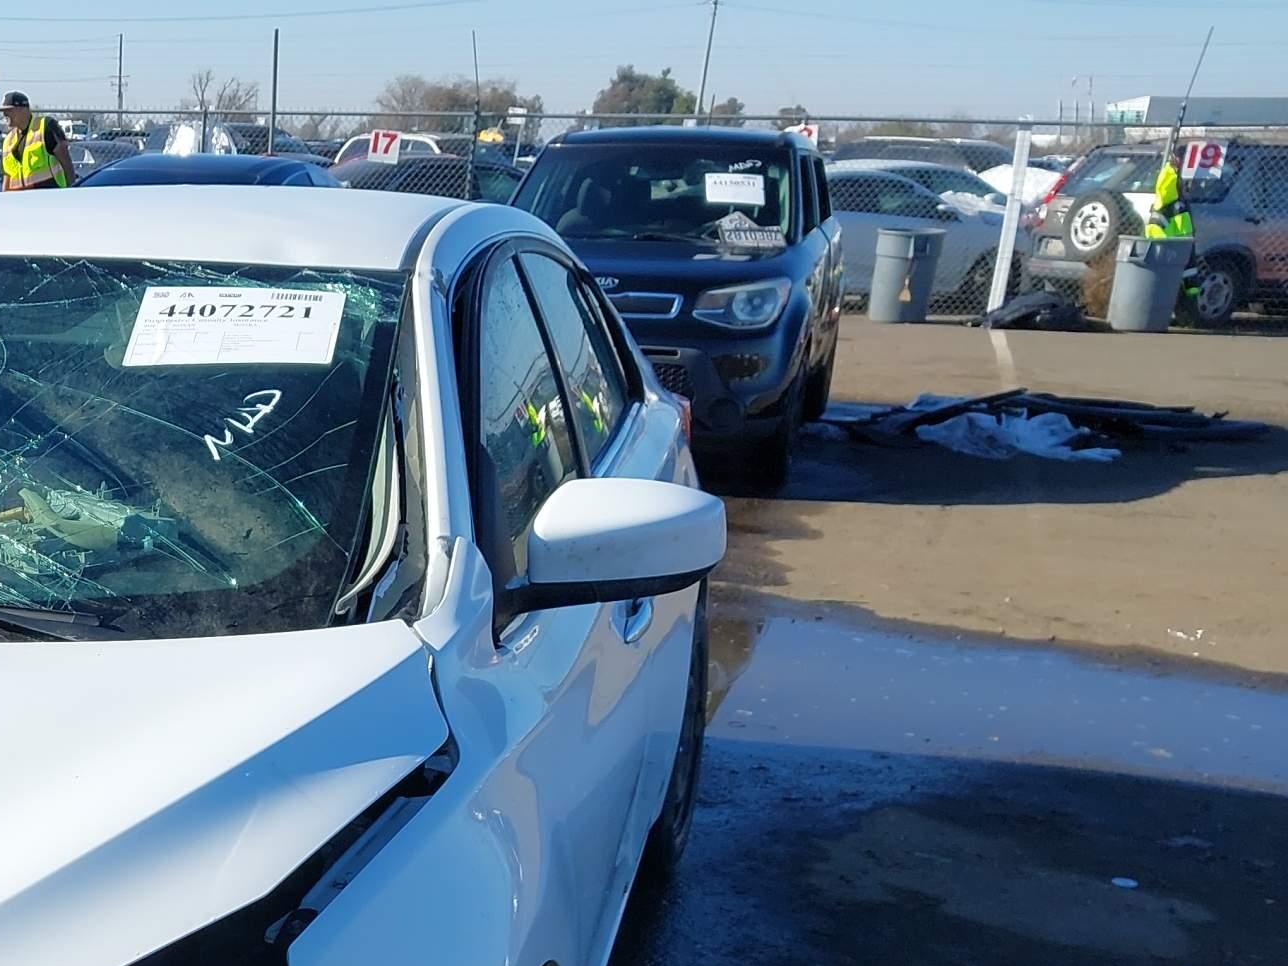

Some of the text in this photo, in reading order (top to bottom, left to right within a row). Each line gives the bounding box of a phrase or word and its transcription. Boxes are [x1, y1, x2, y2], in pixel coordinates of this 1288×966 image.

[371, 131, 398, 154] 17
[1187, 144, 1222, 168] 19
[158, 302, 313, 318] 44072721
